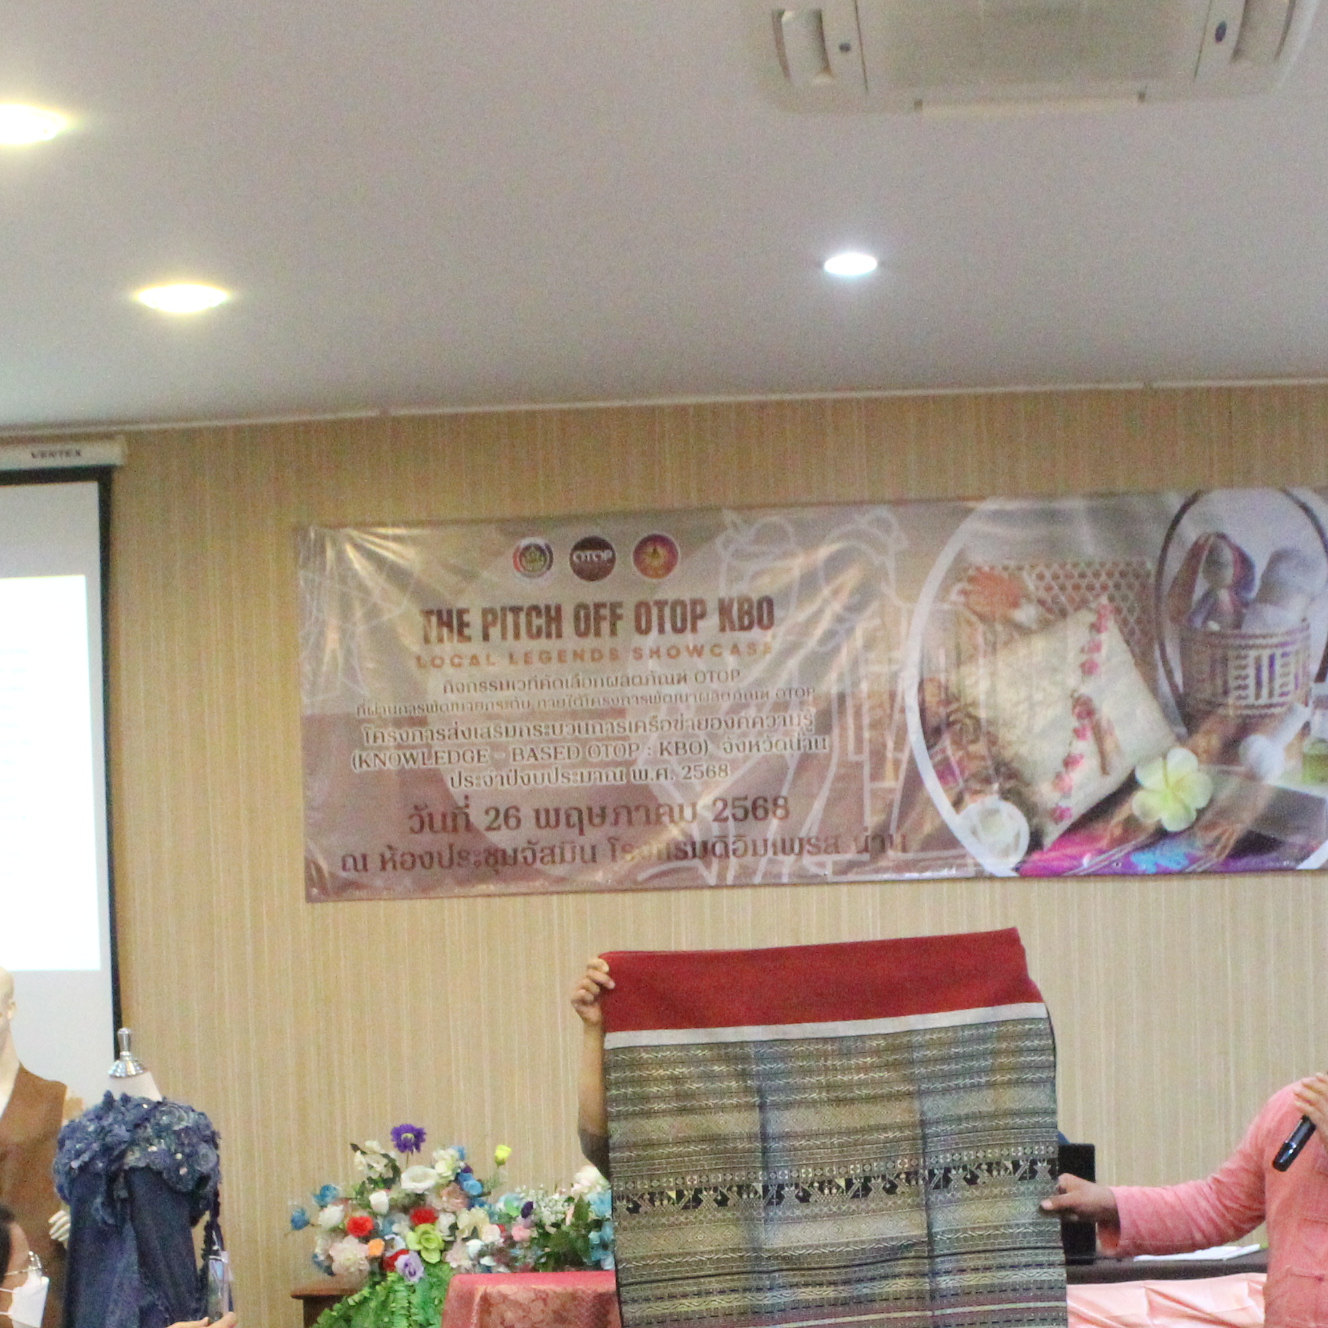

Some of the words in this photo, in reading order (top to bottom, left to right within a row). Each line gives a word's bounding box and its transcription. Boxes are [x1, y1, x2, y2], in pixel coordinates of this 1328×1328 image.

[572, 550, 613, 563] OTOP
[421, 607, 472, 645] THE
[481, 603, 563, 642] PITCH
[573, 601, 624, 638] OFF
[634, 598, 708, 636] OTOP
[718, 595, 775, 633] KBO
[415, 651, 496, 670] LOCAL
[509, 648, 623, 667] LEGENDS
[694, 669, 741, 685] OTOP
[776, 687, 816, 700] OTOP
[352, 748, 490, 771] (KNOWLEDGE
[512, 745, 581, 764] BASED
[588, 741, 640, 760] OTOP
[659, 740, 710, 759] KBO)
[681, 763, 730, 781] 2568
[408, 794, 472, 835] วันที่
[484, 805, 522, 832] 26
[712, 795, 791, 824] 2568
[341, 852, 370, 873] ณ
